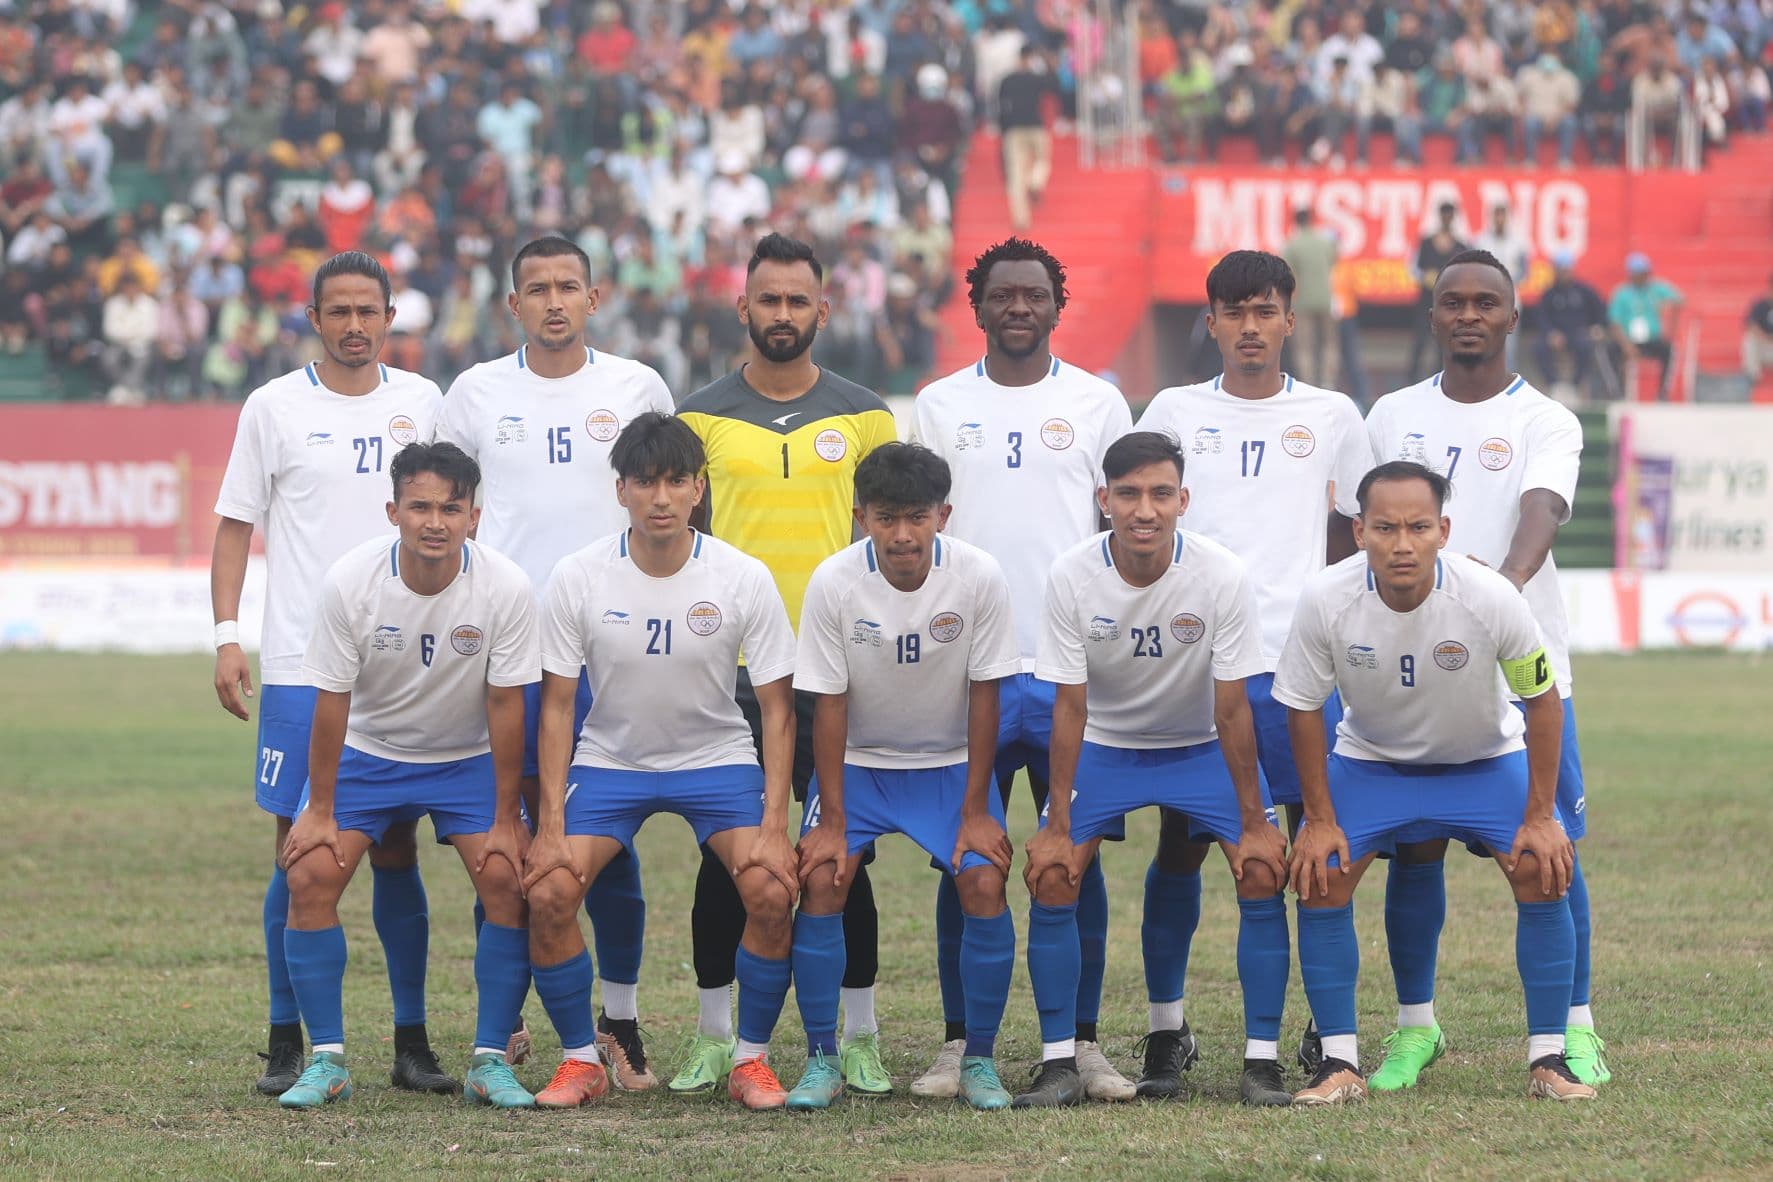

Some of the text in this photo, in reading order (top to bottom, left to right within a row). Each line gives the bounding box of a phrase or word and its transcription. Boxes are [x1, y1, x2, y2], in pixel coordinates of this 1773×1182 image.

[1192, 178, 1589, 260] MUSTANG
[353, 436, 382, 473] 27
[547, 426, 572, 464] 15
[781, 442, 789, 479] 1
[1007, 431, 1022, 468] 3
[1241, 440, 1265, 477] 17
[1446, 446, 1462, 480] 7
[421, 633, 435, 668] 6
[646, 618, 671, 655] 21
[896, 633, 920, 664] 19
[1131, 625, 1163, 658] 23
[1400, 654, 1415, 687] 9
[1535, 652, 1548, 686] C
[260, 746, 285, 787] 27
